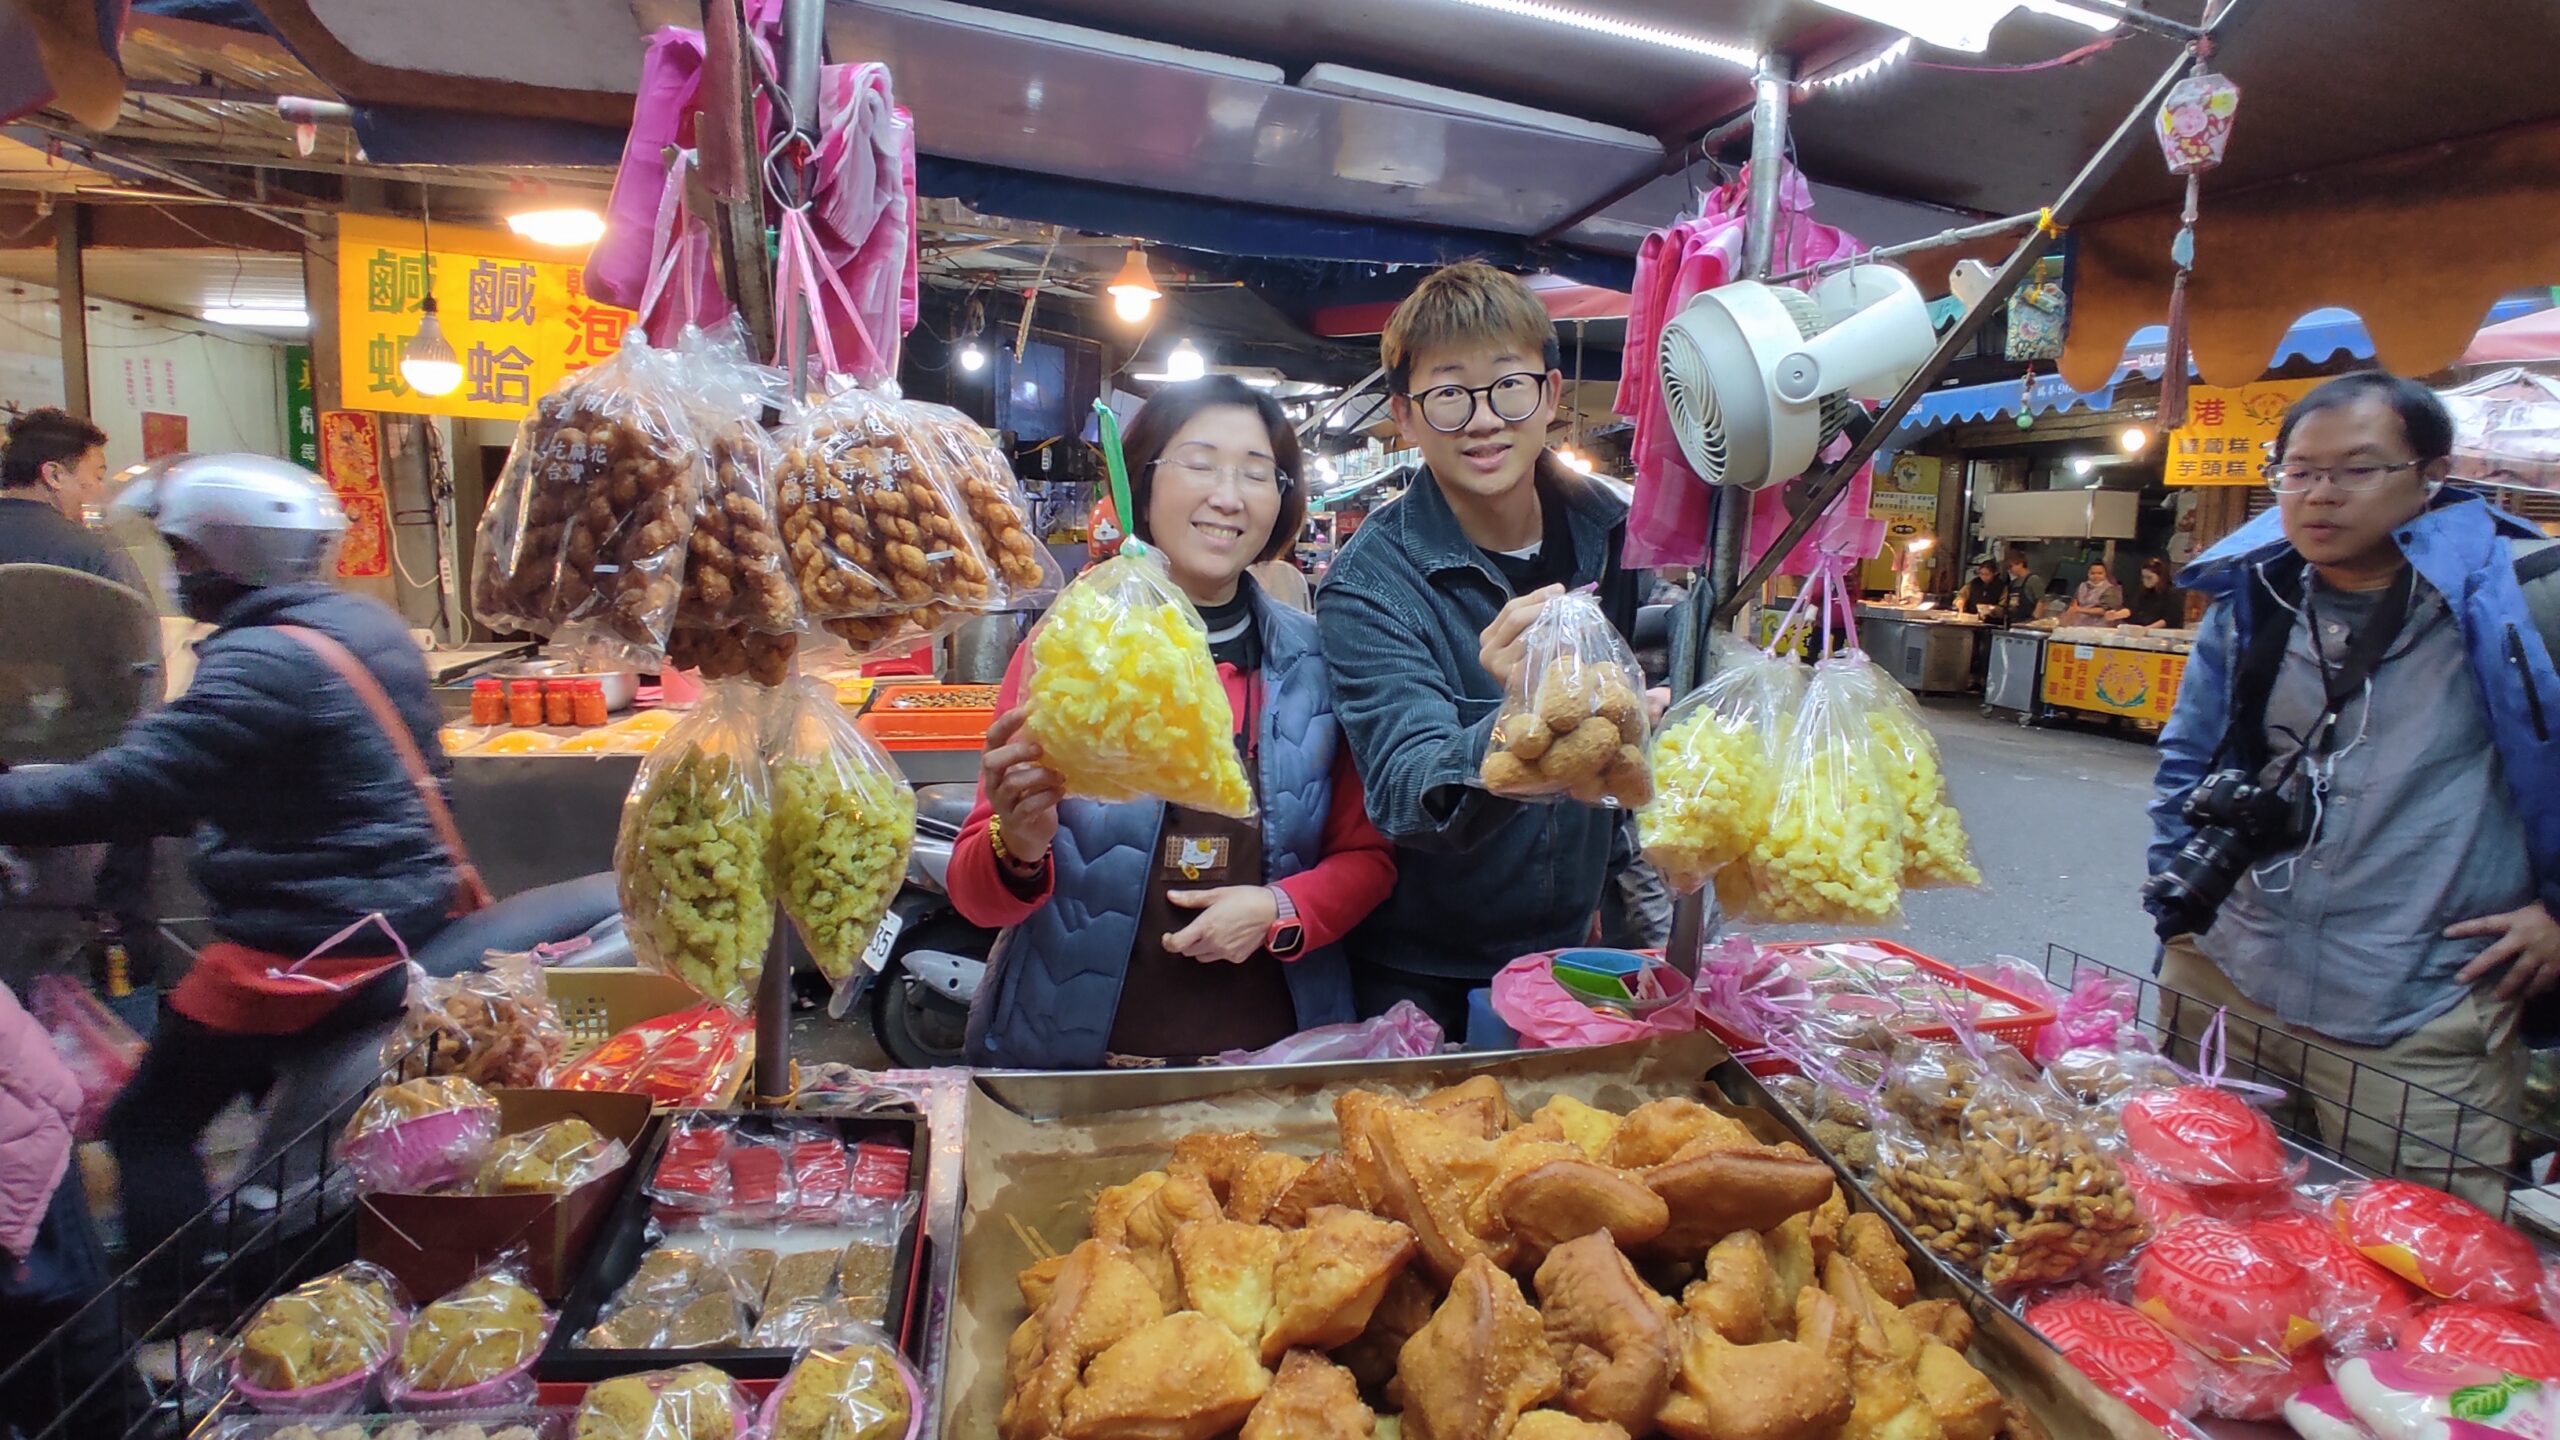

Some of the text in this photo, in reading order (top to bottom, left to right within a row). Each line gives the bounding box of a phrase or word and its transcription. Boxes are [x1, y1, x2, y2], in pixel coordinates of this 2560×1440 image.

[467, 259, 537, 405] 鹹蛤
[2176, 461, 2247, 477] 芋頭糕
